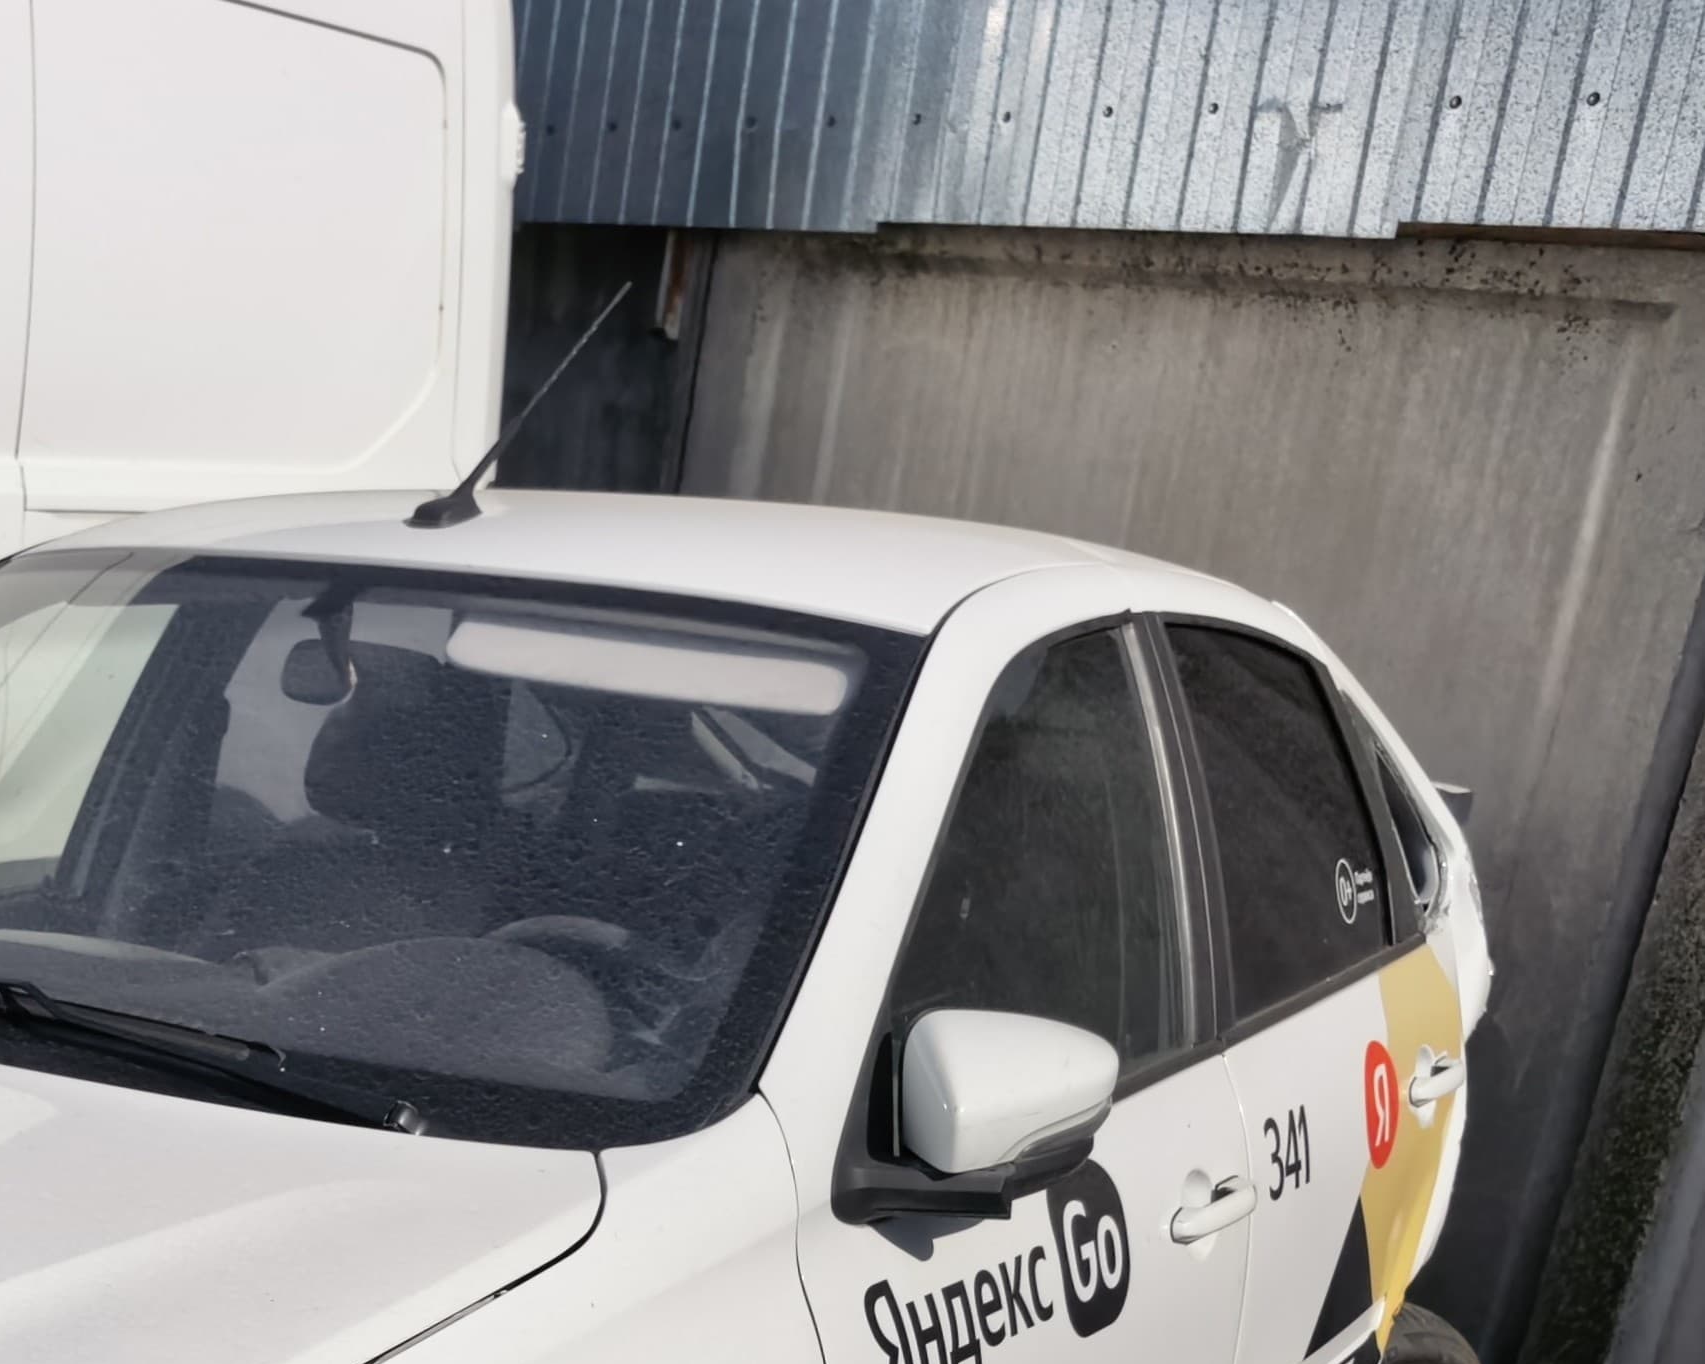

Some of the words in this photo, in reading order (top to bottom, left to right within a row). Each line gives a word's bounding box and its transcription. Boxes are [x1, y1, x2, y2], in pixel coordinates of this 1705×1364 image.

[1263, 1103, 1310, 1202] 341
[1373, 1062, 1390, 1147] Я
[1062, 1199, 1123, 1303] Go
